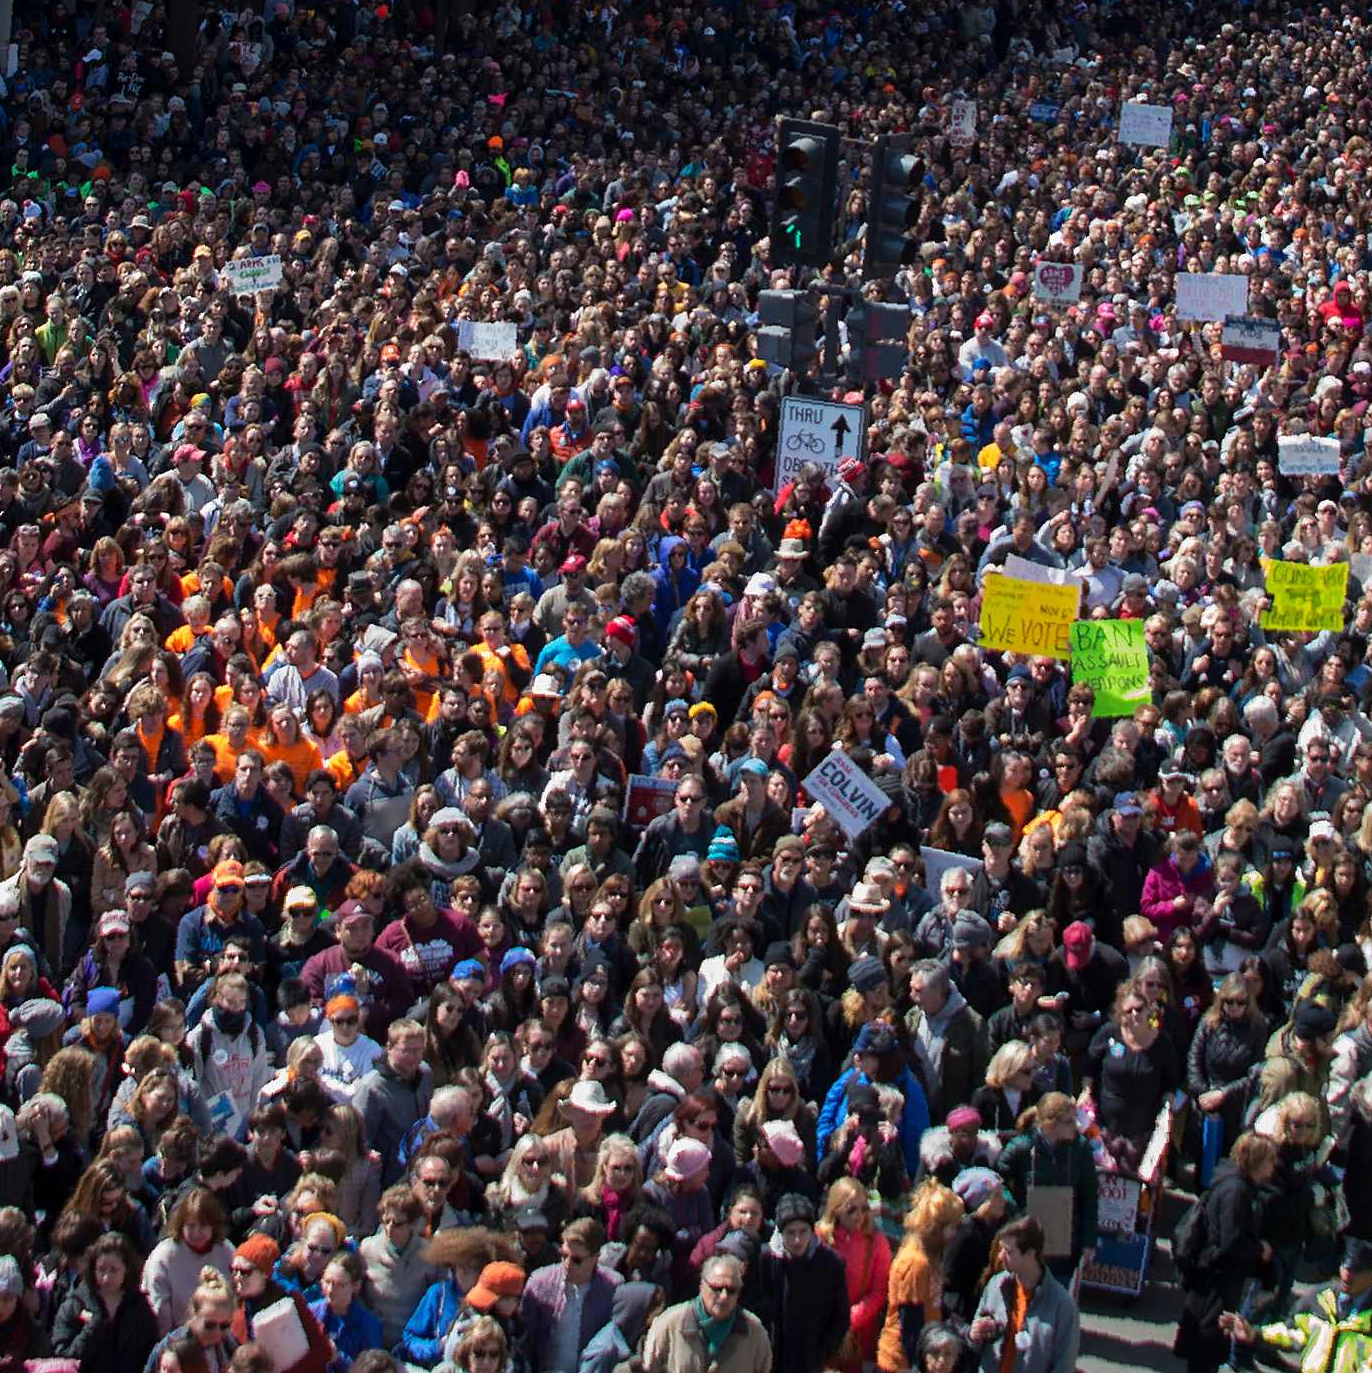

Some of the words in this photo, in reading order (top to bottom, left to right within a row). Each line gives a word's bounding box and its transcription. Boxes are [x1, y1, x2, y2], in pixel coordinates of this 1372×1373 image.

[788, 406, 823, 425] THRU
[1020, 617, 1071, 653] VOTE
[1076, 623, 1133, 653] BAN
[1073, 651, 1143, 673] ASSAULT
[820, 761, 880, 821] COLVIN
